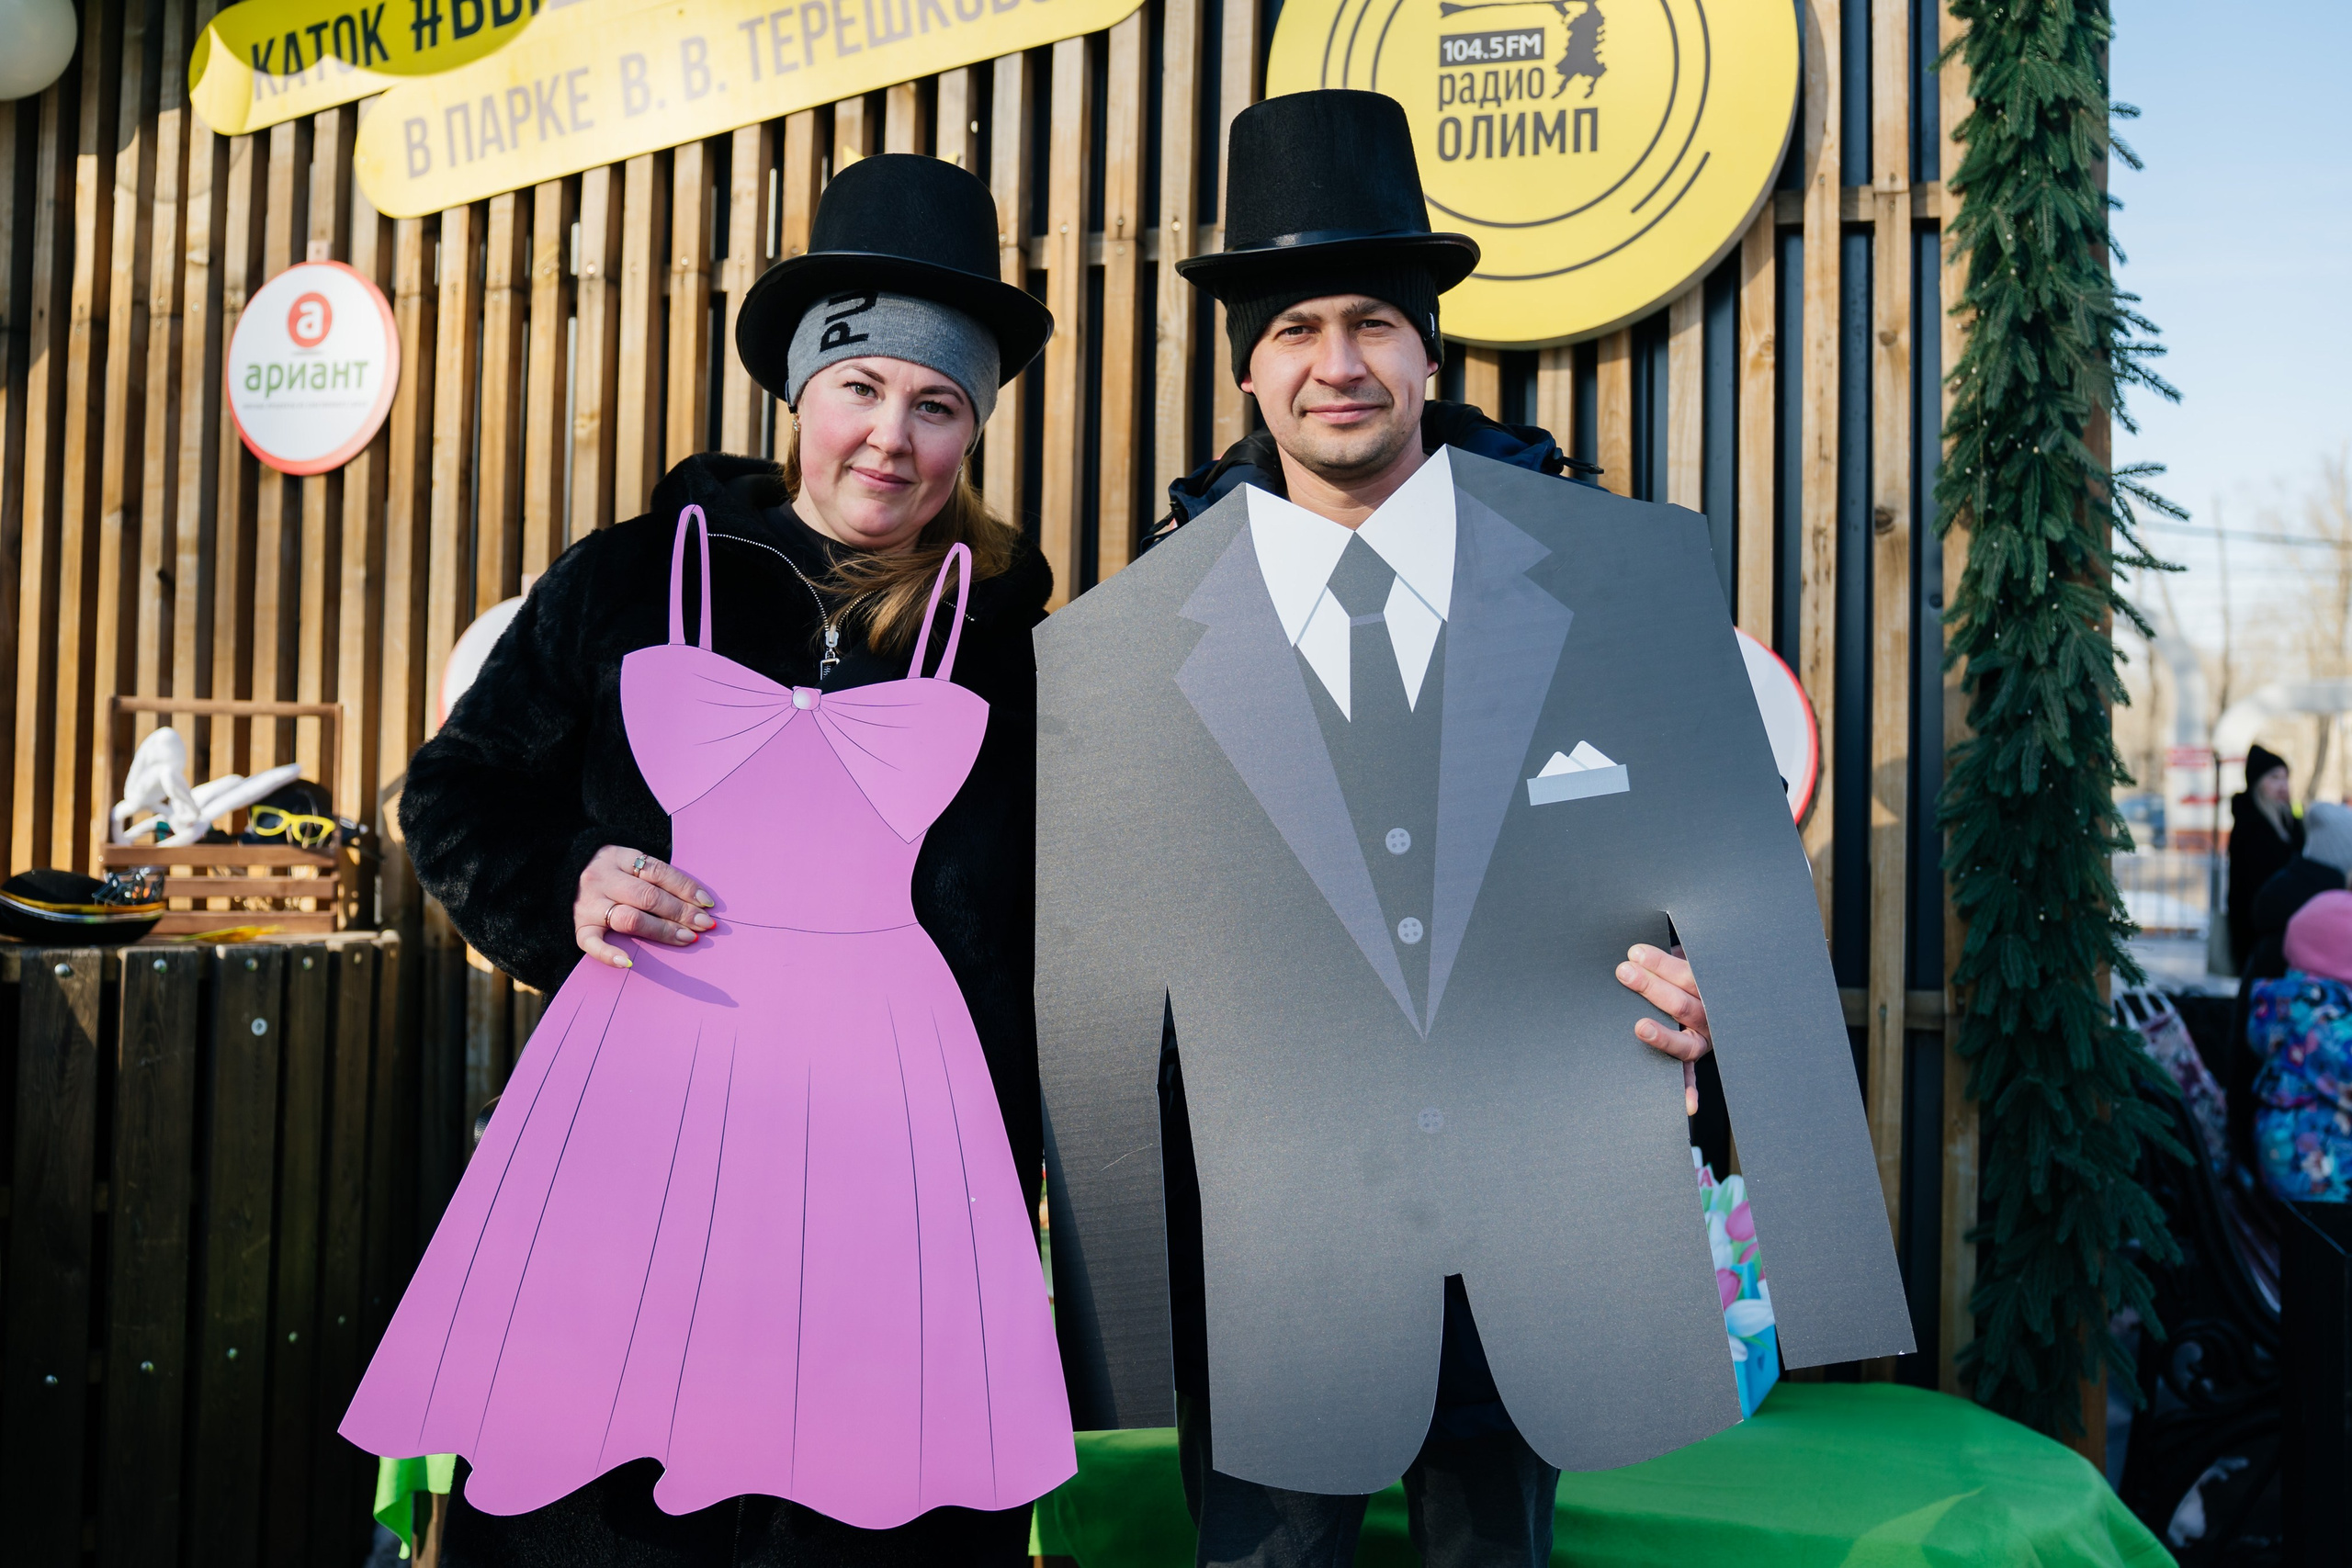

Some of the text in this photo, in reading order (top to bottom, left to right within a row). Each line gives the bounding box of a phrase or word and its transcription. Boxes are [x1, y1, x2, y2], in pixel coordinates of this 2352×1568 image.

[251, 3, 390, 101] КАТОК
[404, 117, 431, 179] В
[445, 66, 594, 167] ПАРКЕ
[619, 51, 666, 118] В.
[680, 36, 727, 101] В.
[1439, 66, 1545, 111] радио
[1438, 107, 1599, 162] ОЛИМП
[243, 360, 370, 399] ариант
